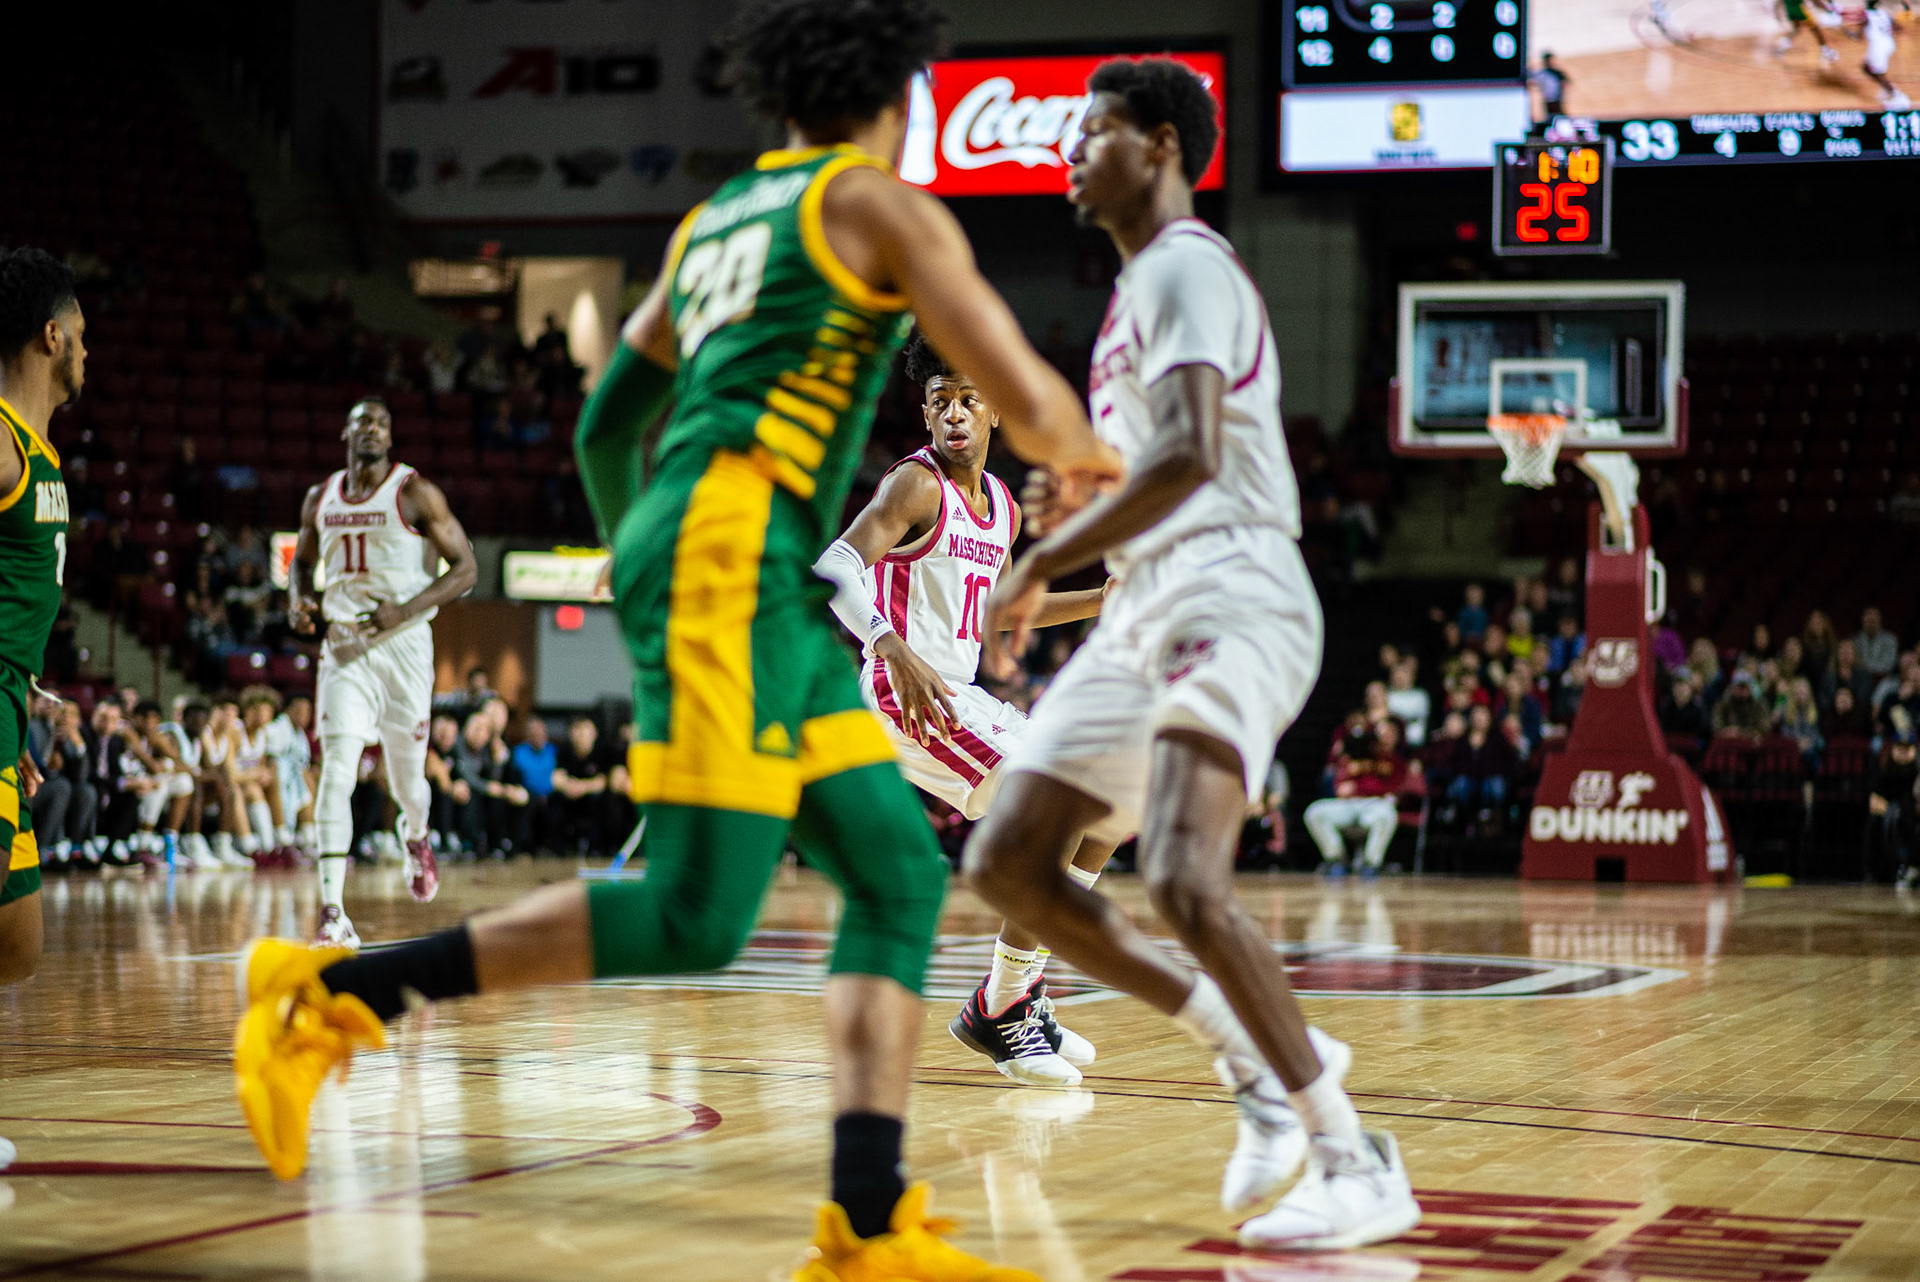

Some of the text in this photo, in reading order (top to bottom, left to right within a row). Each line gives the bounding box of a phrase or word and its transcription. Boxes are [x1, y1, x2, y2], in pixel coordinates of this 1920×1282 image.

[1370, 3, 1394, 30] 2
[1432, 1, 1456, 28] 2
[1621, 120, 1680, 161] 33
[1516, 182, 1590, 243] 25
[341, 532, 369, 573] 11
[956, 572, 991, 643] 10
[1530, 805, 1689, 845] DUNKIN'
